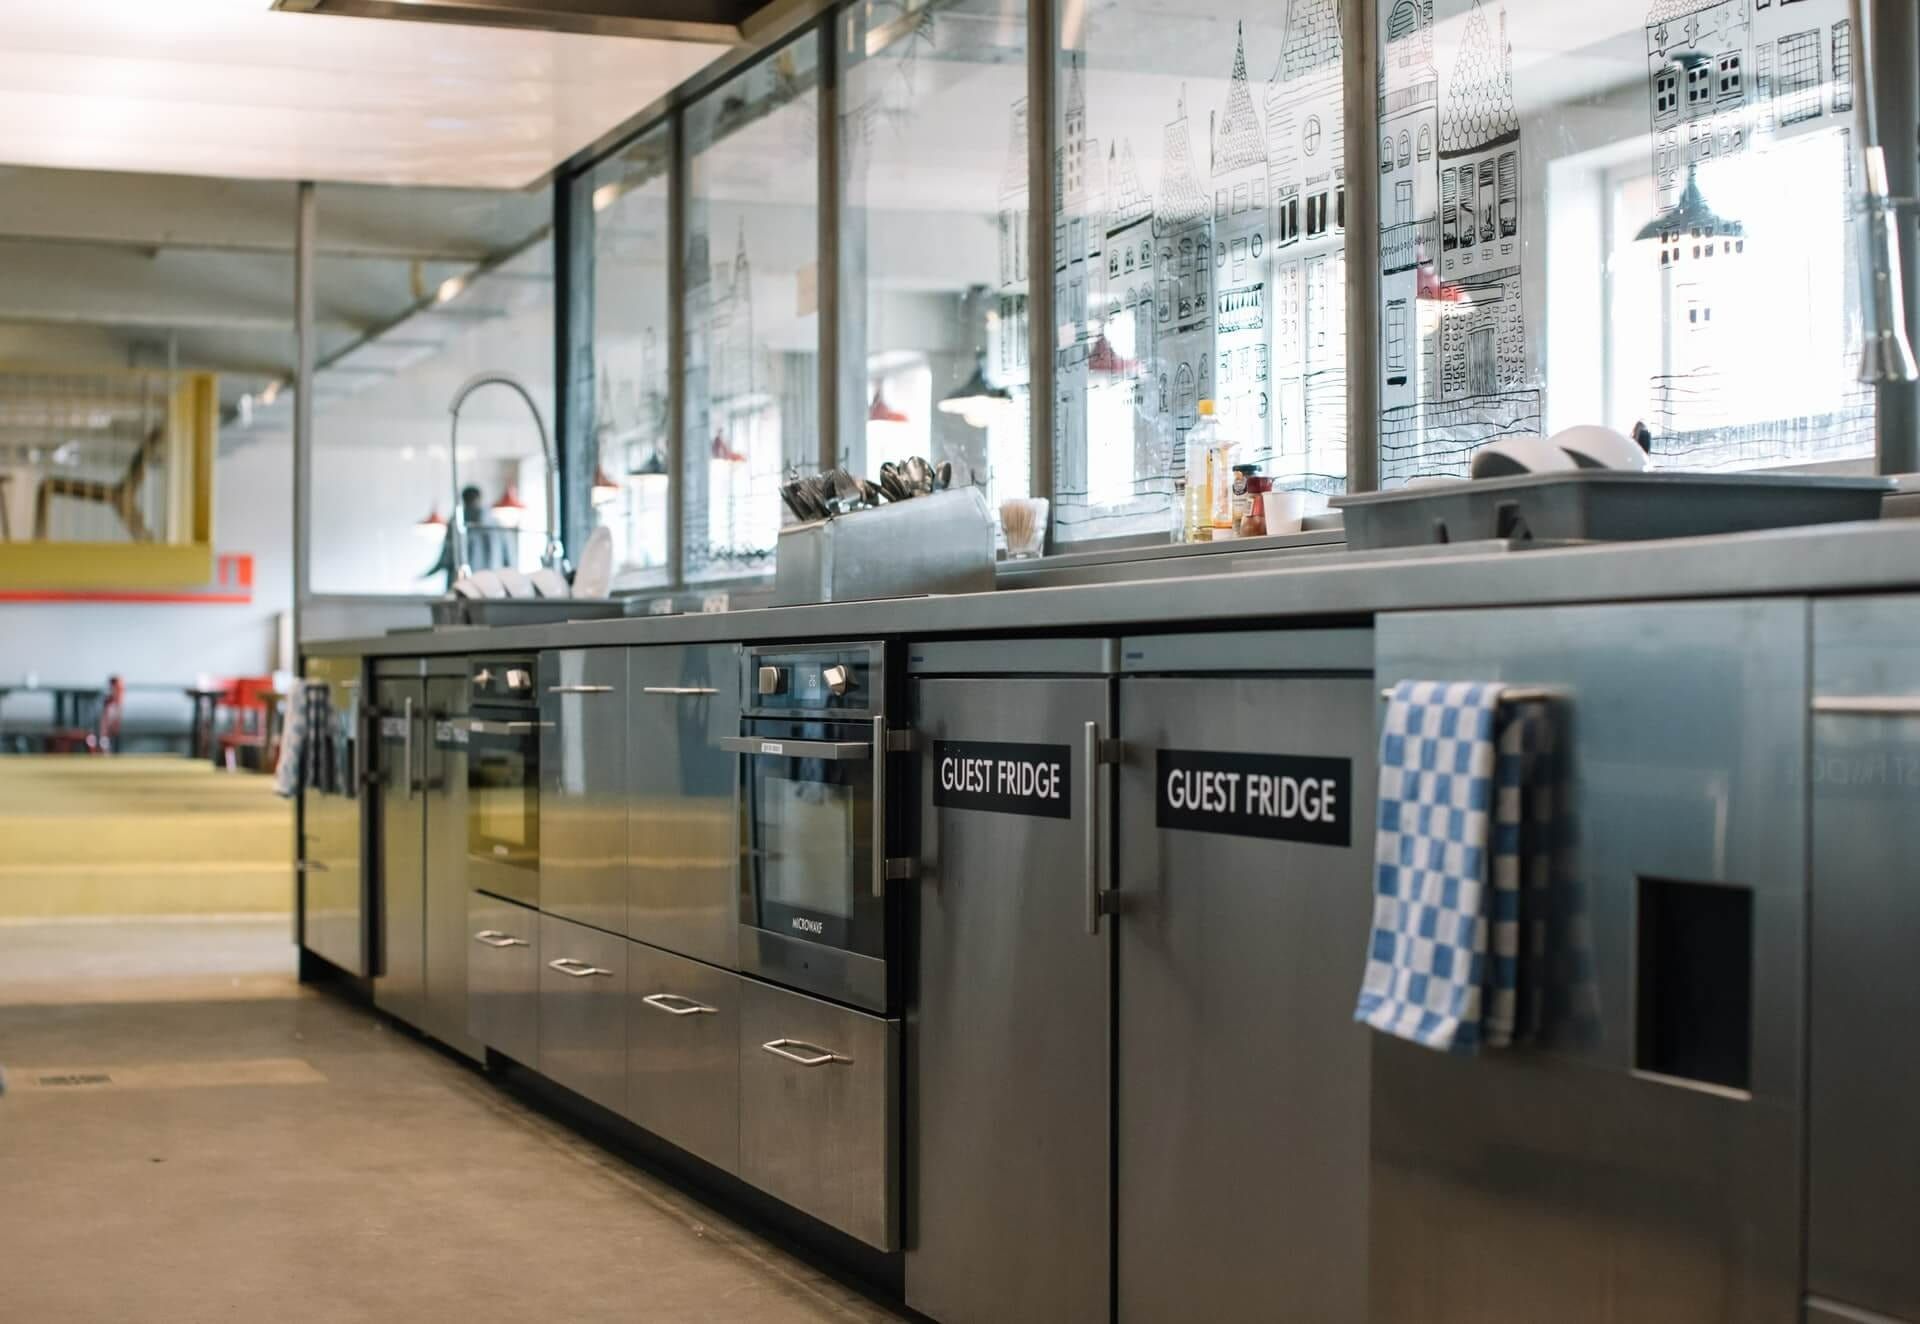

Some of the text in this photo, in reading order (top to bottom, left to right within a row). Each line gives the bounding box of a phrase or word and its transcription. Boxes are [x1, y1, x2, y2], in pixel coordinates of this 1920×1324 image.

[941, 757, 1060, 799] GUEST FRIDGE
[1167, 769, 1336, 822] GUEST FRIDGE
